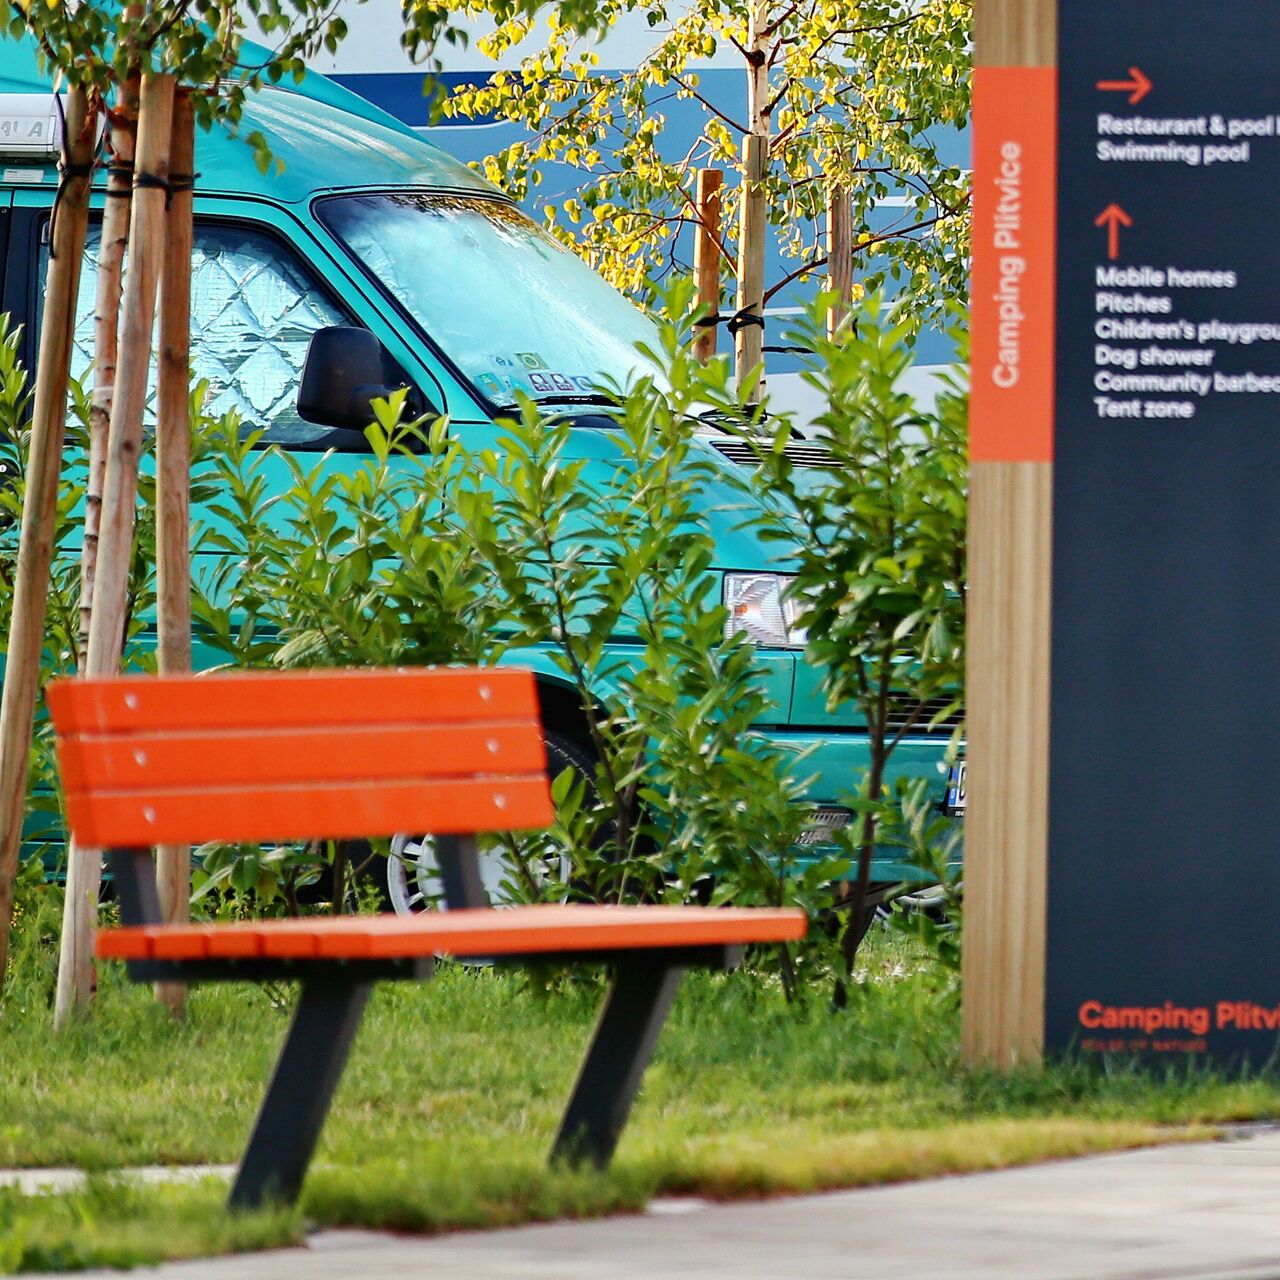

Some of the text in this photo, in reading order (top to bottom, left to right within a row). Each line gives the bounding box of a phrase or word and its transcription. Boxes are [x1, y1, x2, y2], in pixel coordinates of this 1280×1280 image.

[1097, 113, 1206, 136] Restaurant
[1209, 113, 1226, 136] &
[1228, 114, 1274, 140] pool
[1096, 140, 1249, 166] Swimming pool
[992, 140, 1027, 388] Camping Plitvice
[1096, 266, 1237, 289] Mobile homes
[1095, 291, 1172, 314] Pitches
[1094, 318, 1197, 340] Children's
[1095, 344, 1215, 370] Dog shower
[1094, 370, 1212, 397] Community
[1093, 396, 1195, 419] Tent zone
[1079, 1000, 1210, 1035] Camping
